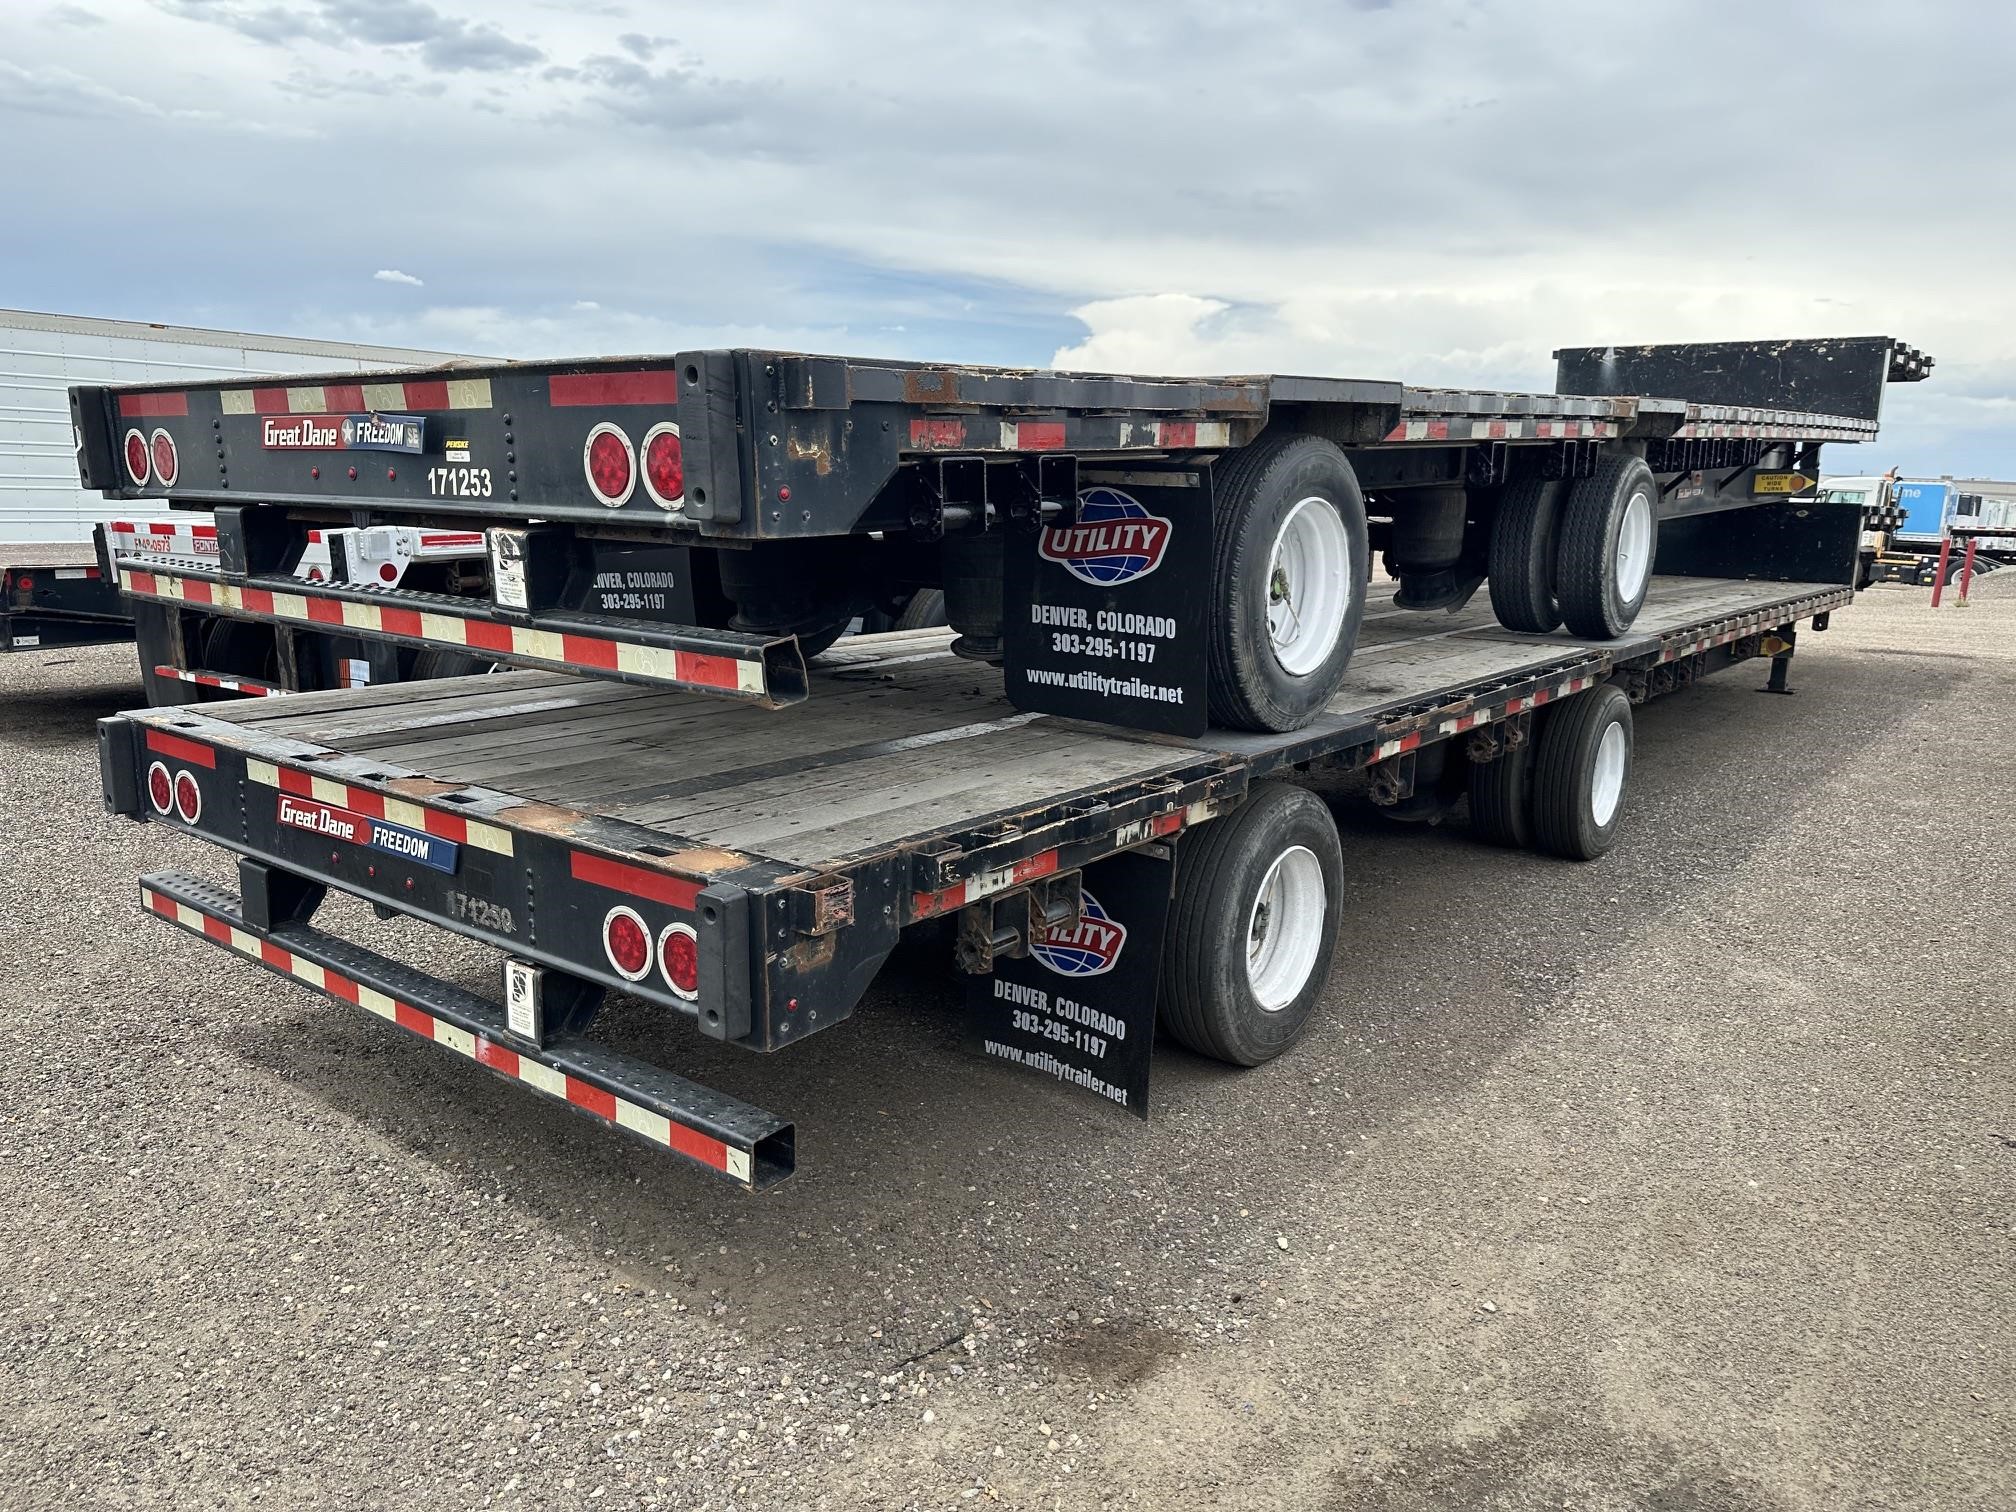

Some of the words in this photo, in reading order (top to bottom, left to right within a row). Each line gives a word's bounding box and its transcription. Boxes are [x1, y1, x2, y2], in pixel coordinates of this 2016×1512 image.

[264, 420, 300, 446] Great
[302, 419, 337, 446] Dane
[356, 422, 404, 446] FREEDOM
[407, 429, 419, 443] SE
[428, 467, 492, 497] 171253
[194, 540, 219, 553] FONTA
[1051, 525, 1160, 553] UTILITY
[627, 572, 674, 588] COLORADO
[601, 593, 665, 610] 303-295-1197
[1031, 604, 1092, 631] DENVER,
[1096, 611, 1176, 639] COLORADO
[1052, 633, 1156, 663] 303-295-1197
[1026, 668, 1184, 705] www.utilitytrailer.net
[280, 799, 317, 829] Great
[319, 809, 354, 840] Dane
[373, 826, 429, 860] FREEDOM
[1049, 923, 1118, 952] ILITY
[993, 979, 1052, 1014] DENVER,
[1056, 996, 1126, 1041] COLORADO
[1012, 1009, 1108, 1059] 303-295-1197
[984, 1039, 1128, 1106] www.utilitytrailer.net
